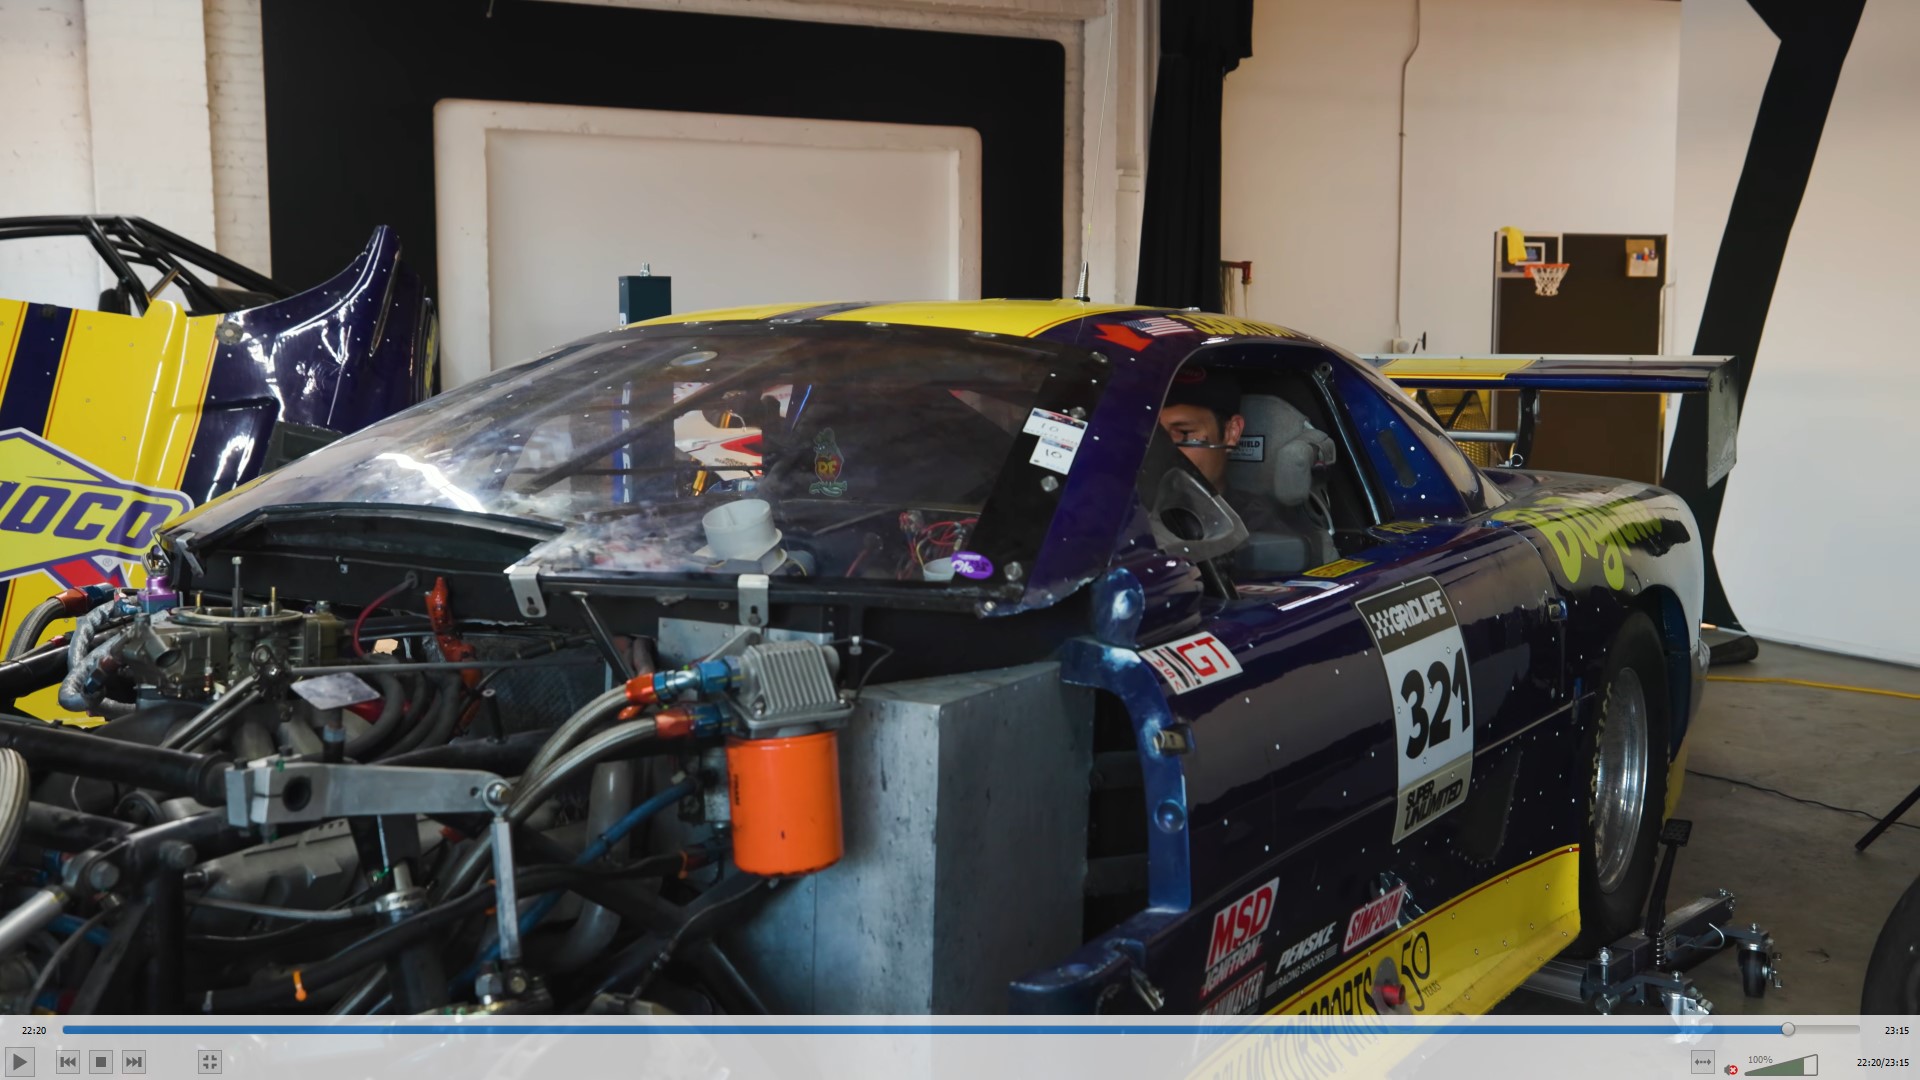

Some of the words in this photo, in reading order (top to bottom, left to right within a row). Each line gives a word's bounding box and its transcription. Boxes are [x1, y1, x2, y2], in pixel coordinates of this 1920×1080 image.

[1045, 448, 1062, 460] 10
[1388, 589, 1447, 632] GRIDLIFE
[1176, 636, 1230, 678] GT
[1400, 648, 1471, 760] 321
[1404, 778, 1464, 831] UNLIMITED
[1406, 779, 1435, 810] SUPER
[1208, 886, 1273, 968] MSD
[1347, 892, 1401, 945] SIMPSON
[1202, 935, 1264, 997] IGNITION
[1275, 921, 1338, 975] PENSKE
[1277, 966, 1300, 988] RACING
[1300, 951, 1326, 975] SHOCKS
[1401, 931, 1431, 1011] 50
[1421, 980, 1442, 999] YEARS
